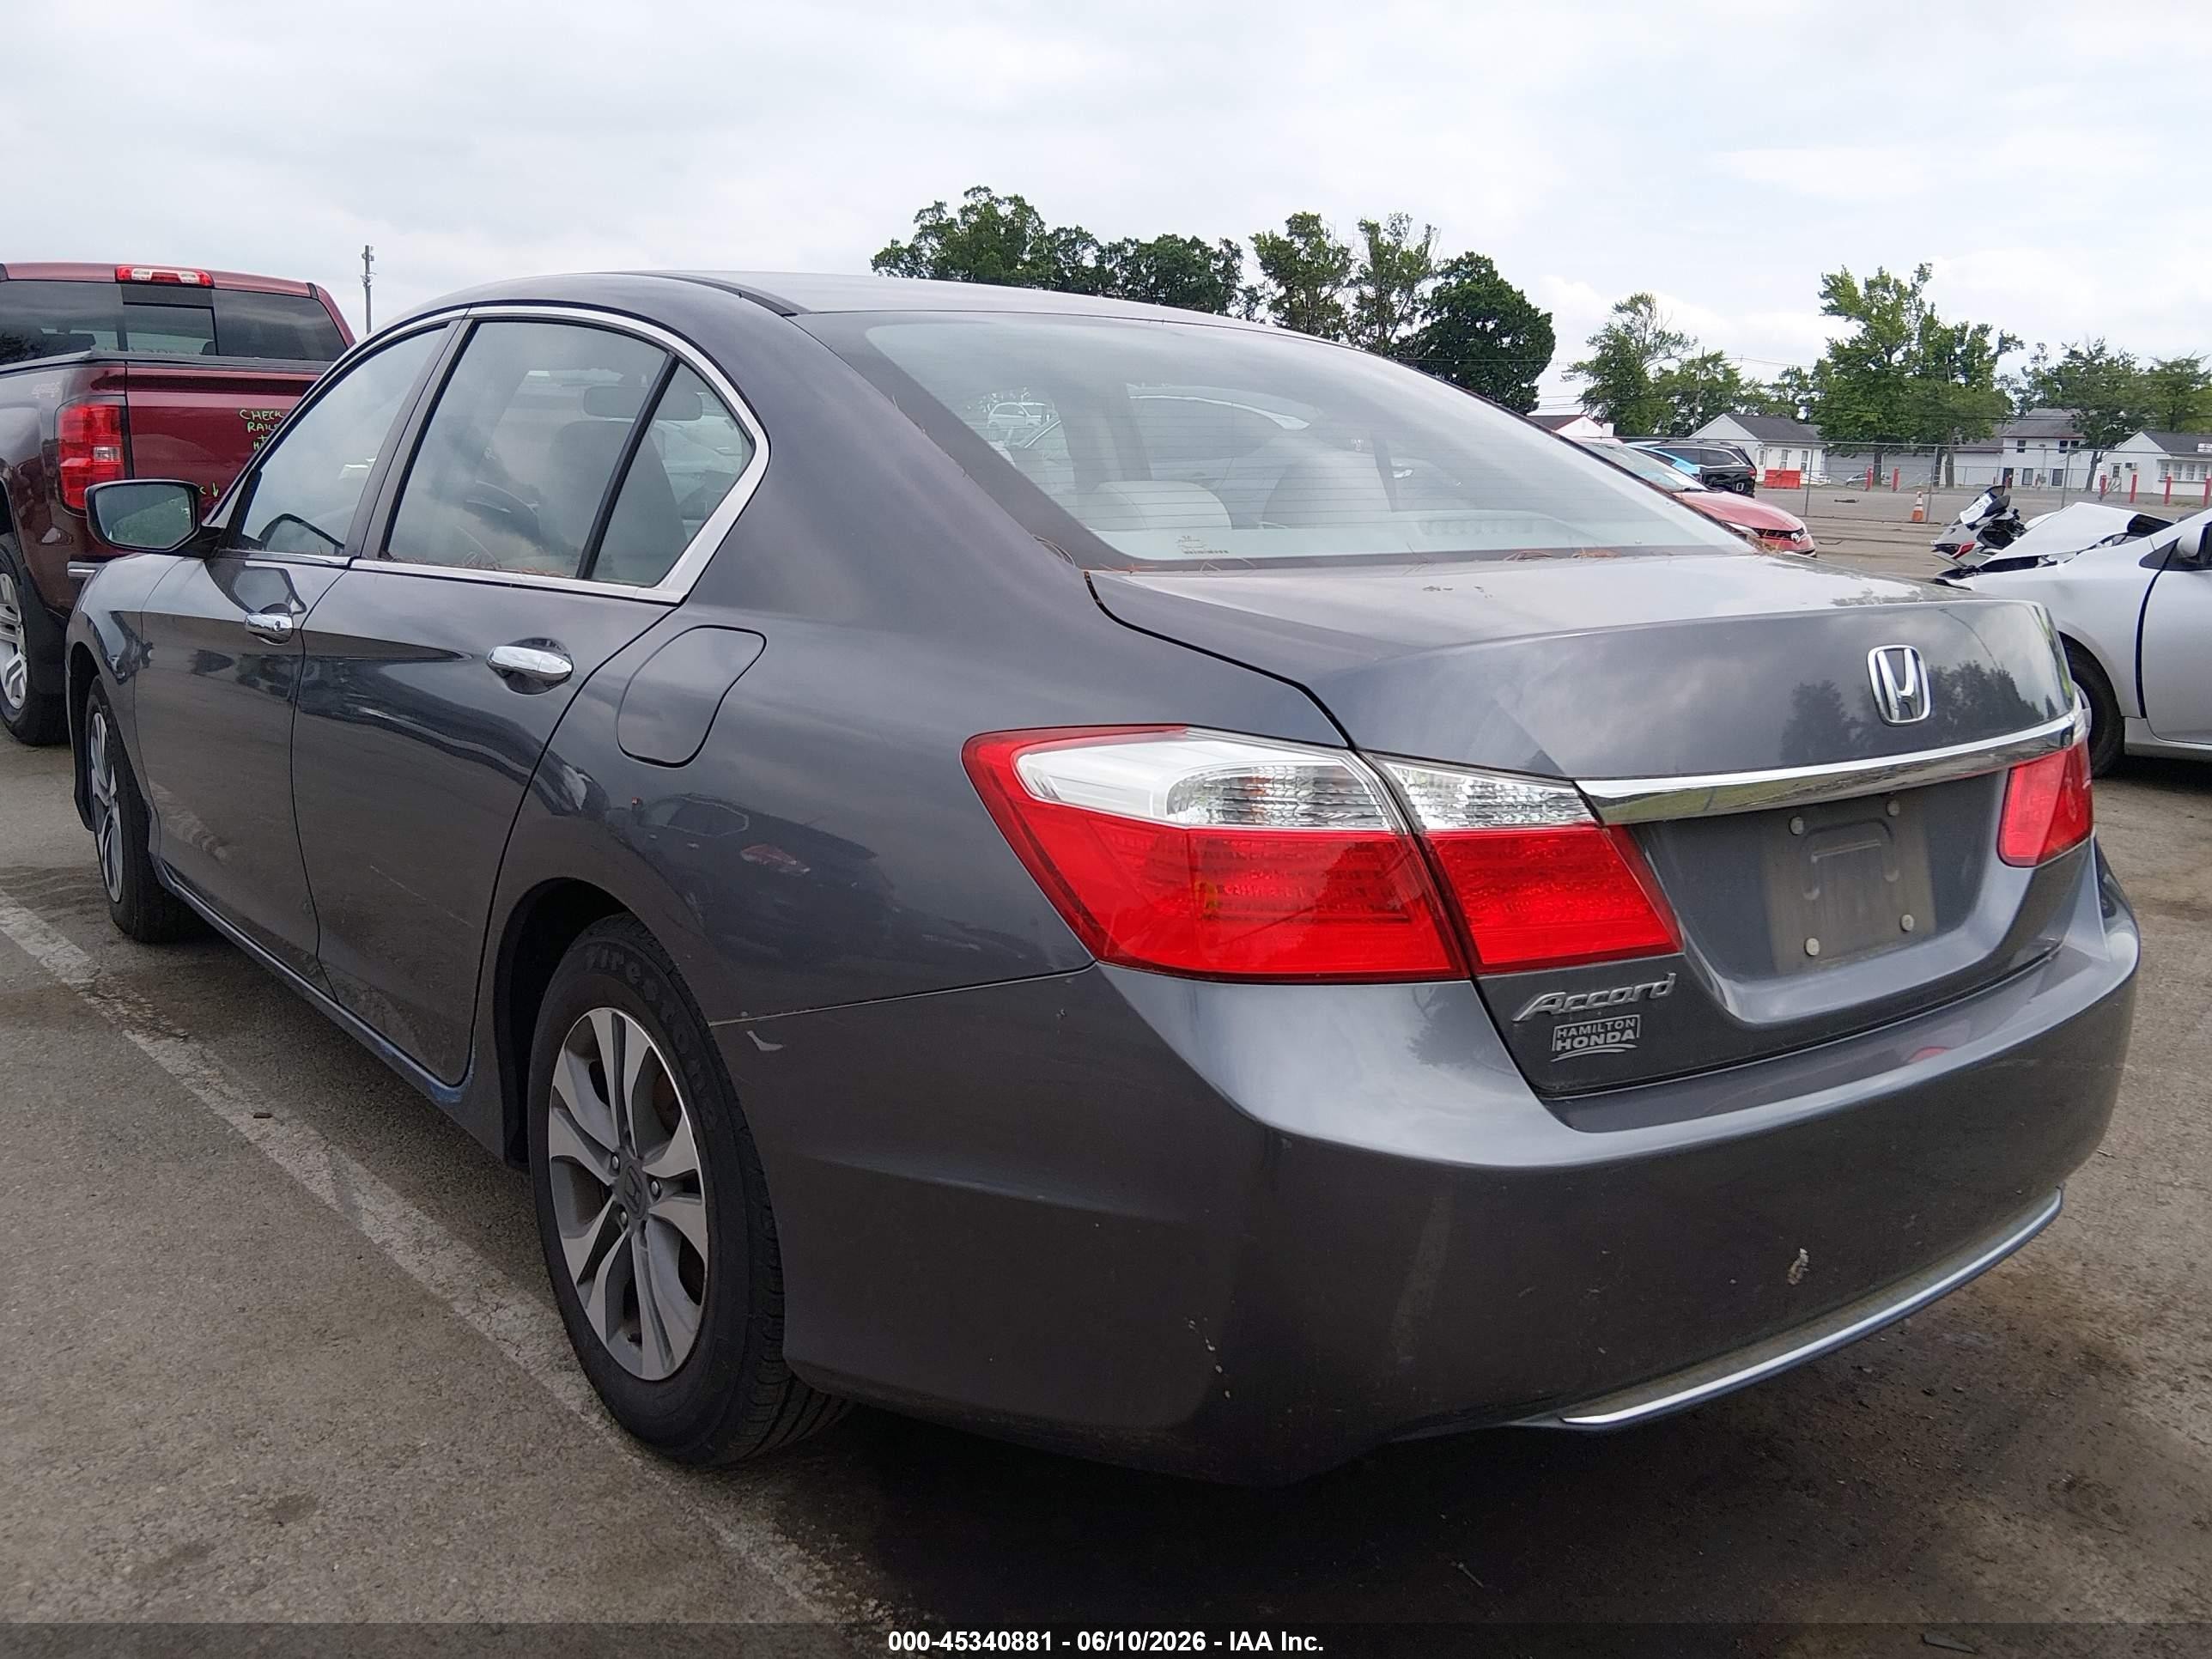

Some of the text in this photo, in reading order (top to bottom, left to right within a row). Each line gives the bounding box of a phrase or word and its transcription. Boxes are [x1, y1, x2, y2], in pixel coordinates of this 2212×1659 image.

[240, 409, 285, 421] CHECK
[1511, 973, 1676, 1022] Accord
[1557, 1018, 1636, 1039] HAMILTON
[1555, 1029, 1636, 1052] HONDA
